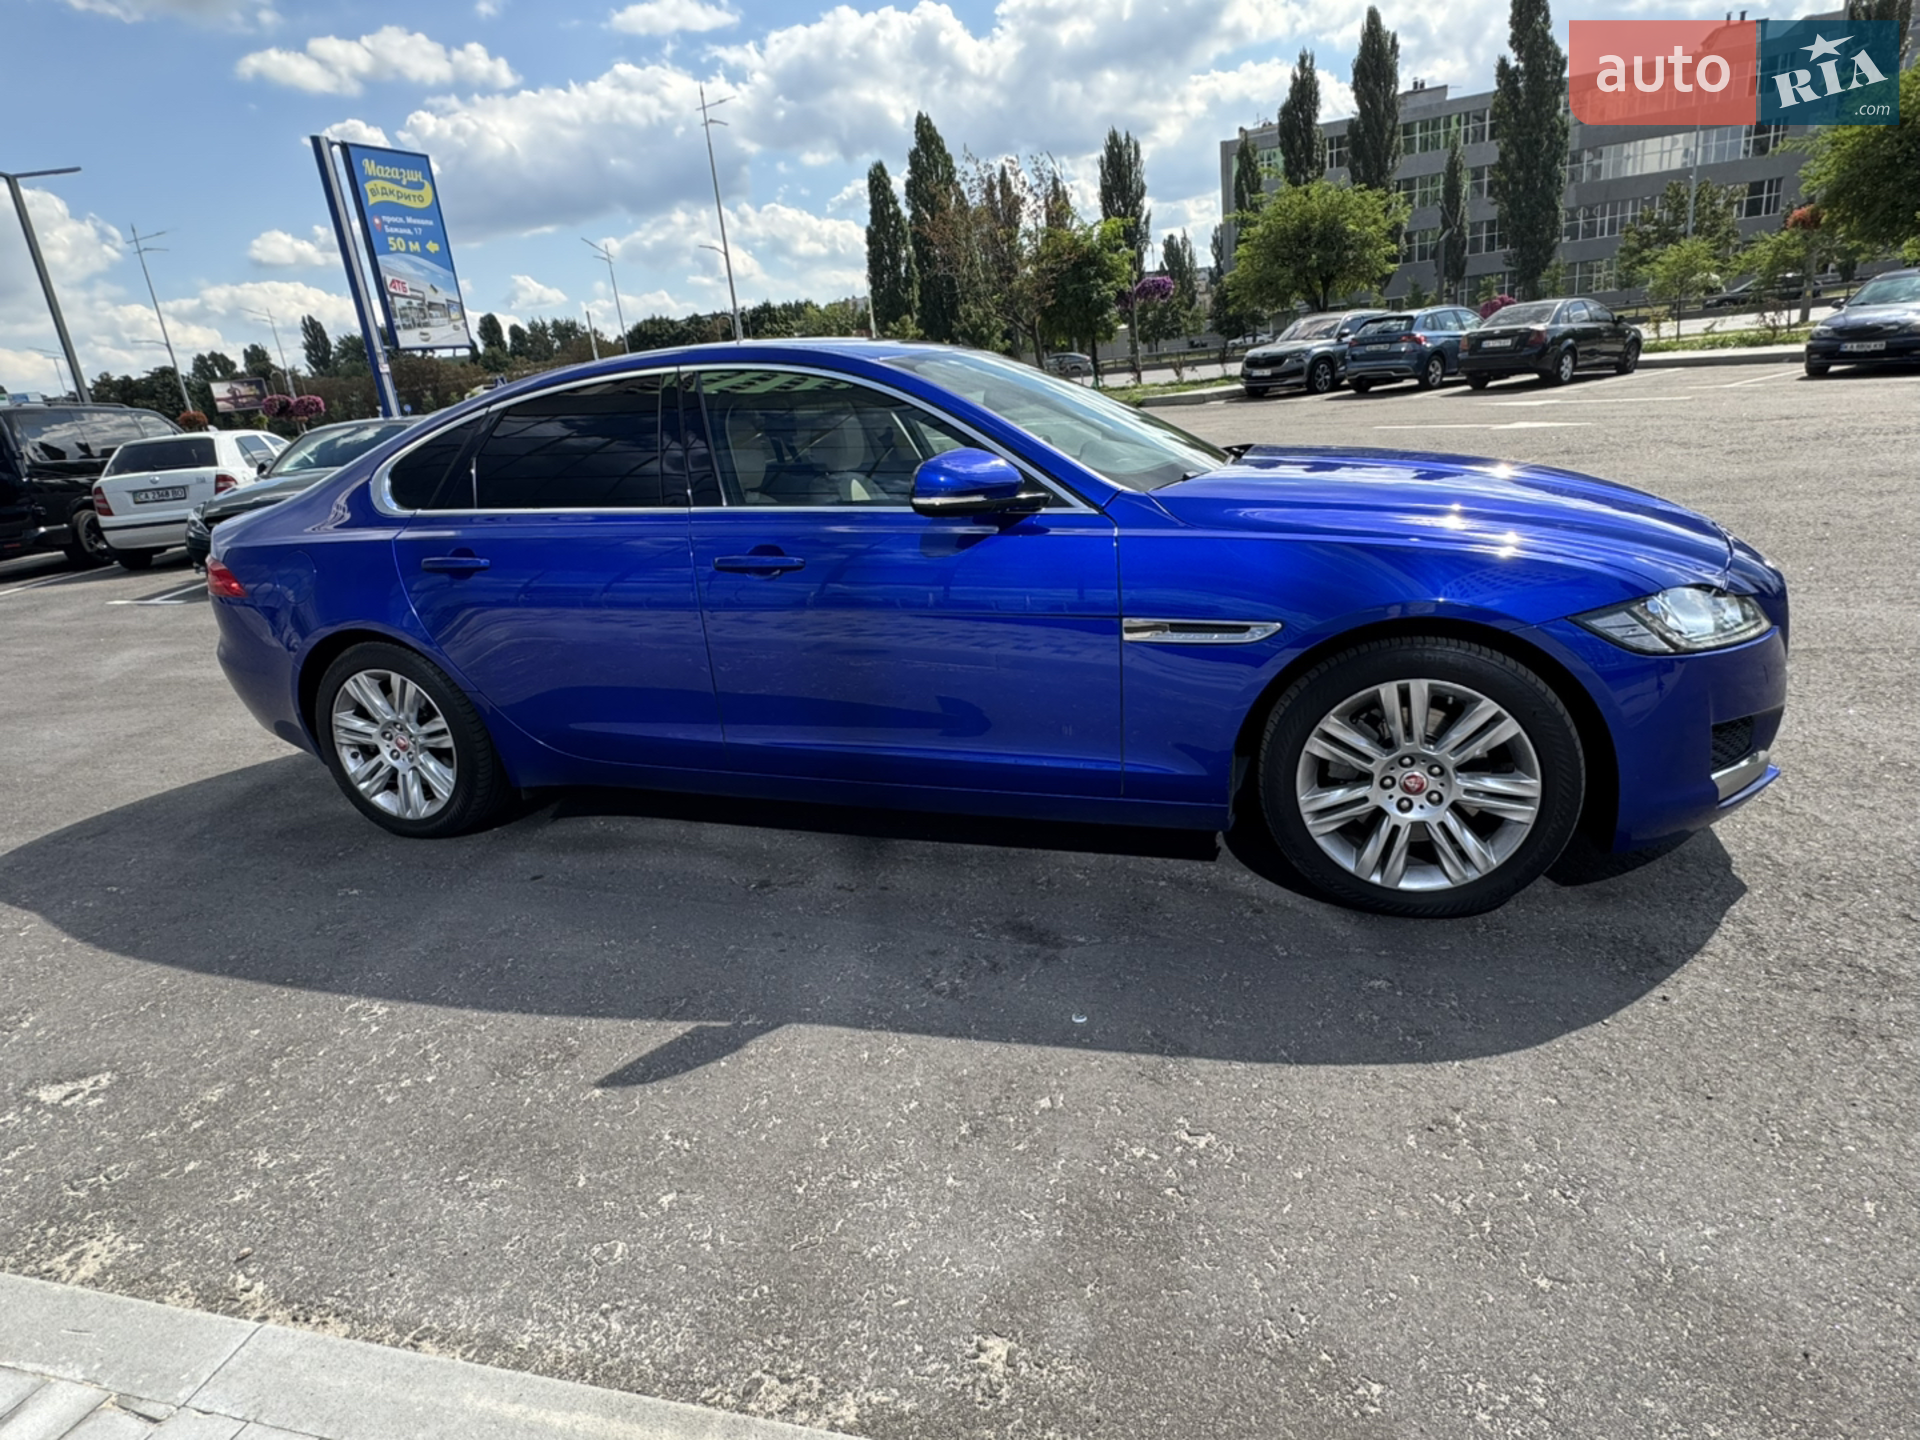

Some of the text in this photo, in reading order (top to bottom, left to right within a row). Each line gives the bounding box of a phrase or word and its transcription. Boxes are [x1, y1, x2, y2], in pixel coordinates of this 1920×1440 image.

[362, 158, 423, 185] Магазин
[369, 184, 425, 203] відкрито
[413, 227, 422, 235] 17
[387, 236, 421, 253] 50 м
[389, 278, 409, 294] АТБ
